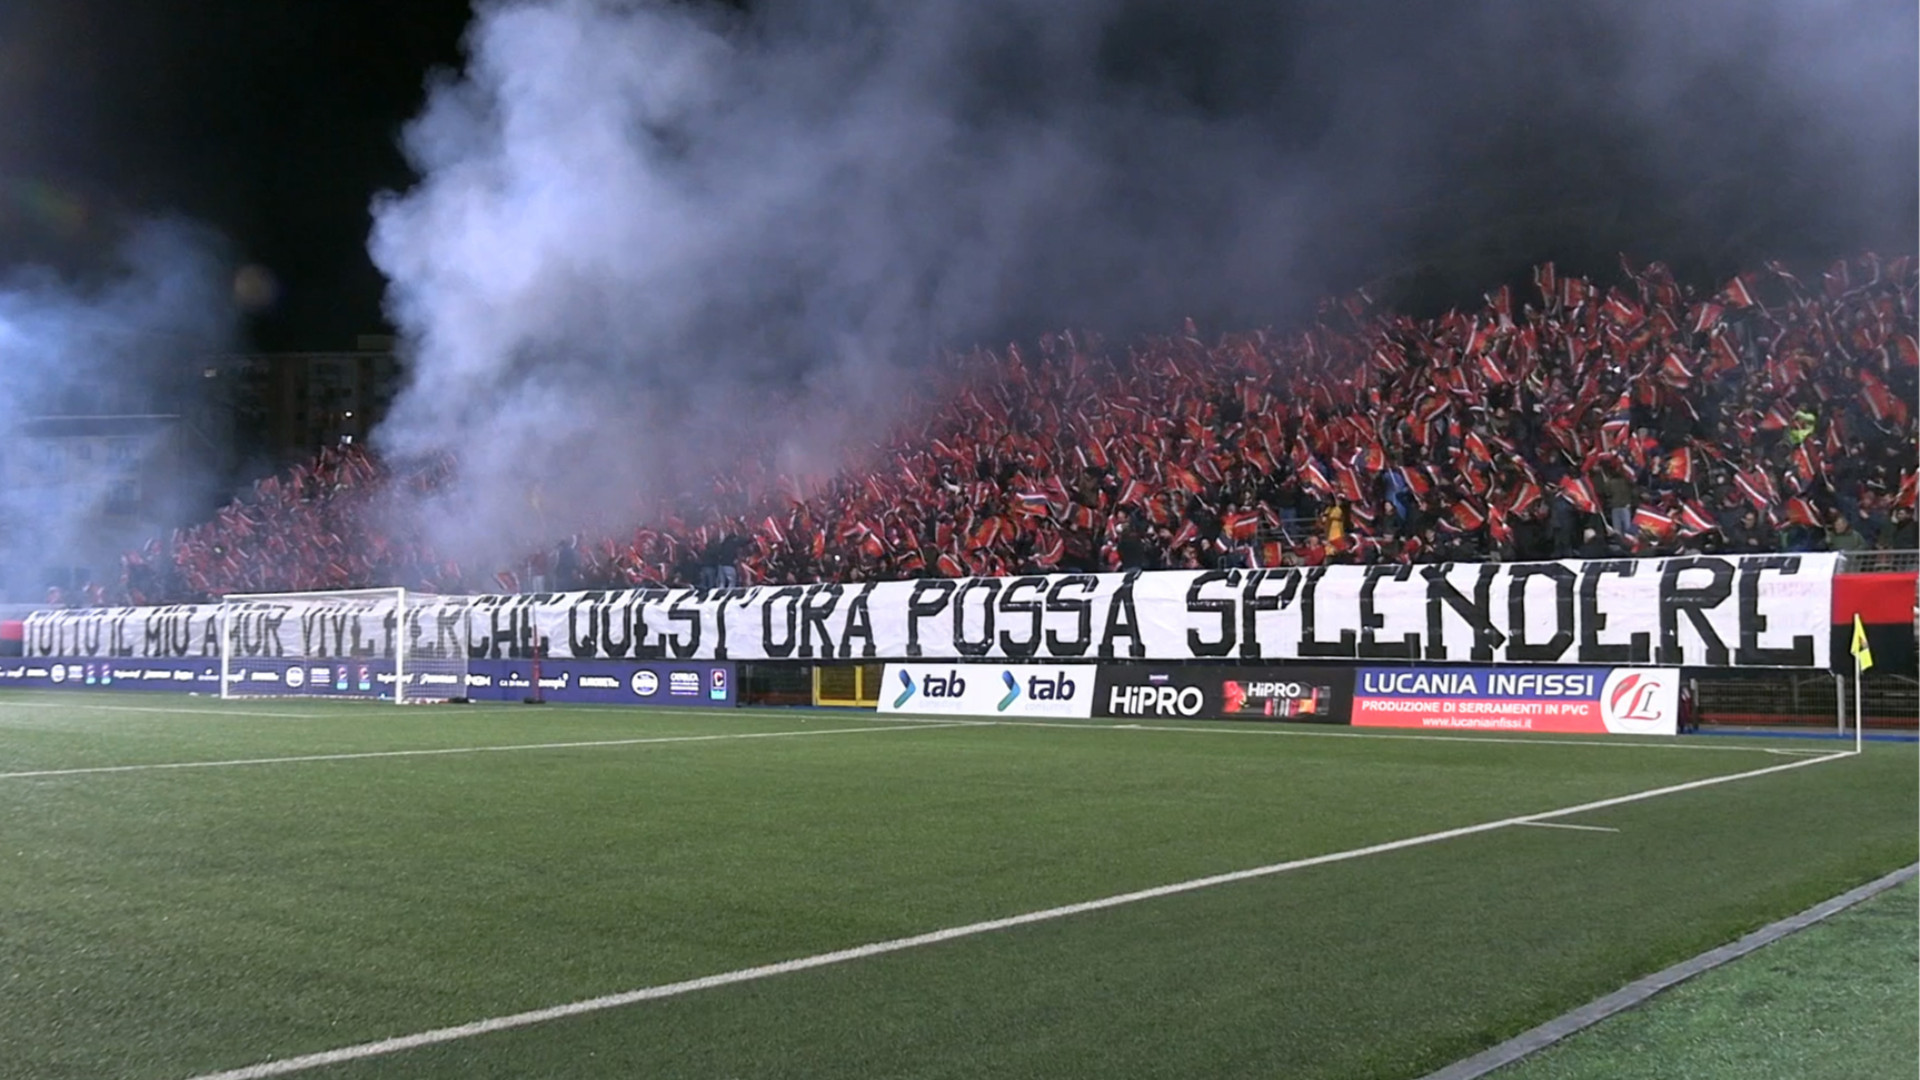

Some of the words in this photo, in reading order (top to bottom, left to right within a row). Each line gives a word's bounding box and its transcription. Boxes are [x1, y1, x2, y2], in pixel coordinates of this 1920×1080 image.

[25, 609, 108, 657] TUTTO
[109, 607, 136, 657] IL
[143, 604, 197, 657] MIO
[301, 601, 381, 658] VIVE
[906, 567, 1146, 658] POSSA
[1186, 556, 1815, 666] SPLENDERE
[923, 669, 966, 698] tab
[1028, 671, 1076, 700] tab
[1248, 682, 1301, 699] HiPRO
[1364, 673, 1478, 695] LUCANIA
[1488, 674, 1594, 696] INFISSI
[1109, 685, 1204, 716] HiPRO
[1362, 700, 1440, 713] PRODUZIONE
[1443, 702, 1455, 713] DI
[1458, 702, 1541, 715] SERRAMENTI
[1545, 704, 1558, 715] IN
[1561, 704, 1589, 716] PVC
[1422, 715, 1532, 729] www.lucaniainfissi.it
